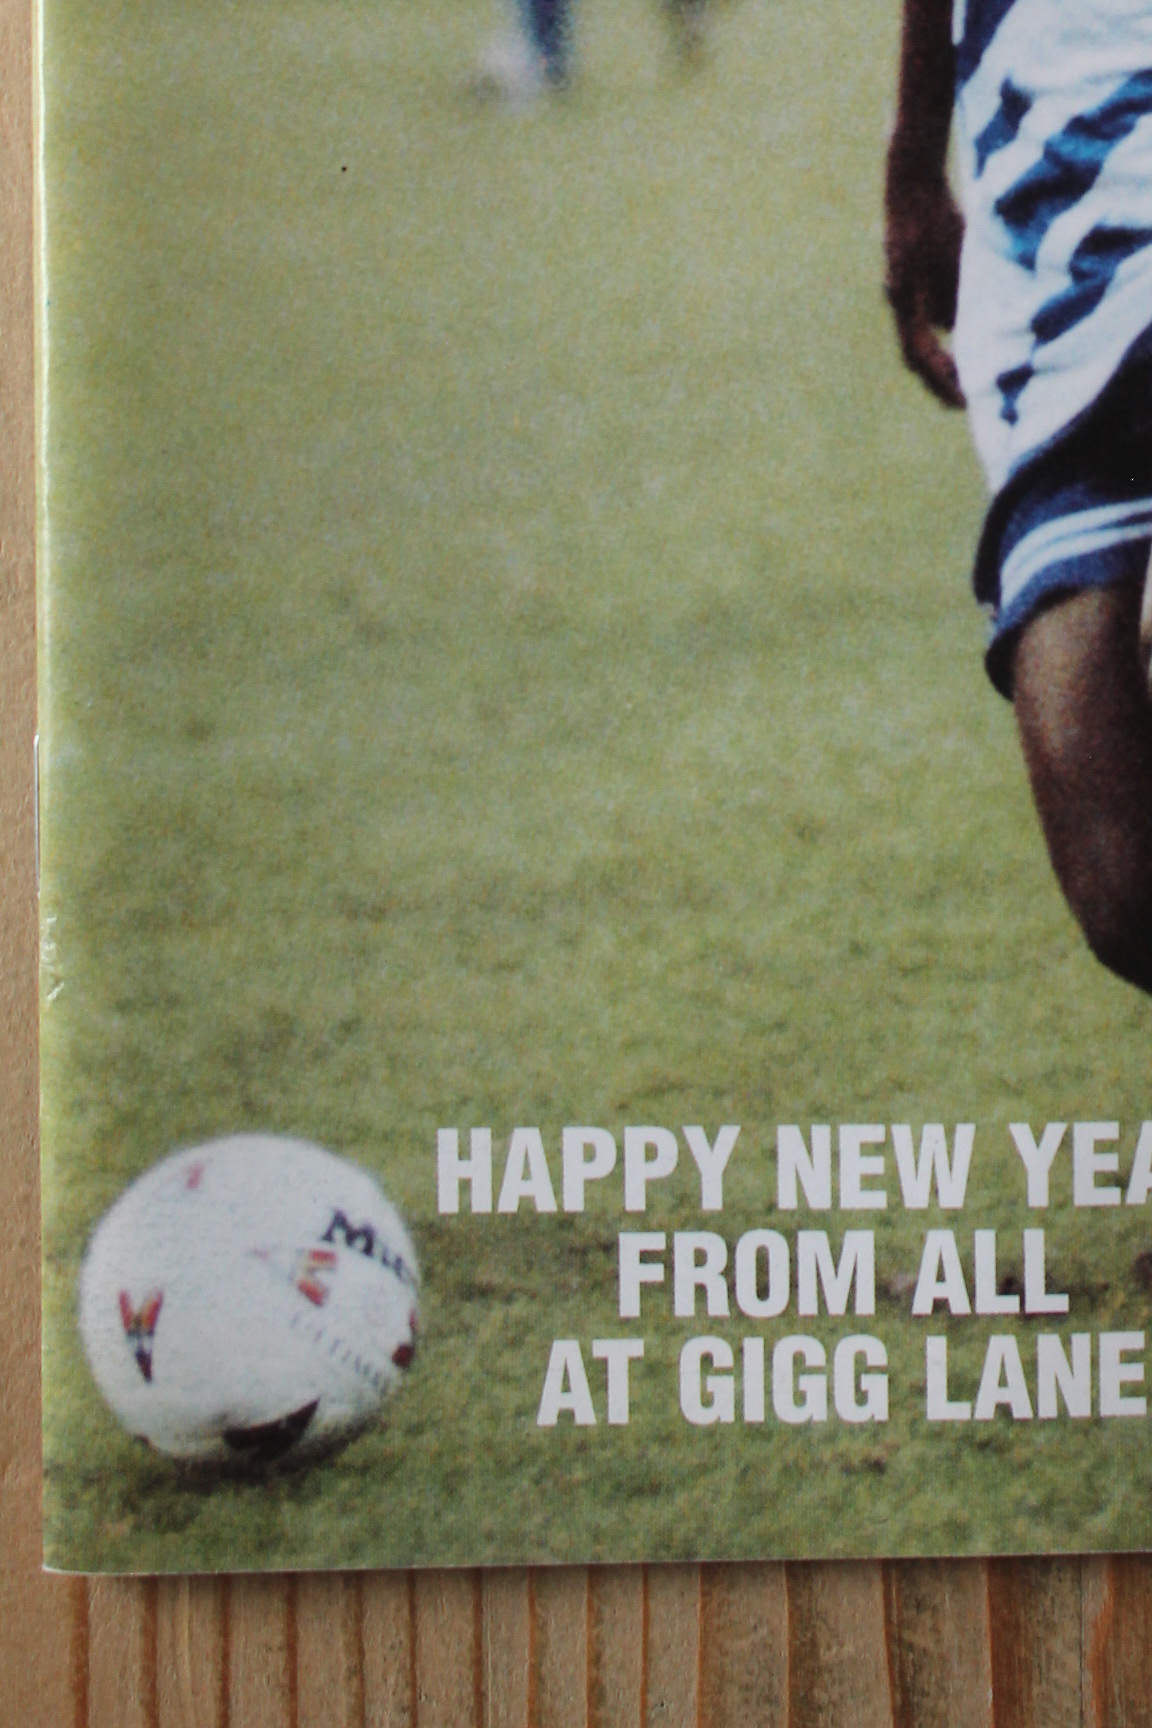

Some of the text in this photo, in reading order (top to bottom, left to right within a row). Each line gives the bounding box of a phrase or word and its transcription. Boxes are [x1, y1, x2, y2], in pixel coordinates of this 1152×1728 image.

[436, 1125, 741, 1214] HAPPY
[777, 1123, 977, 1210] NEW
[617, 1228, 1070, 1318] FROM ALL
[536, 1331, 1147, 1426] AT GIGG LANE
